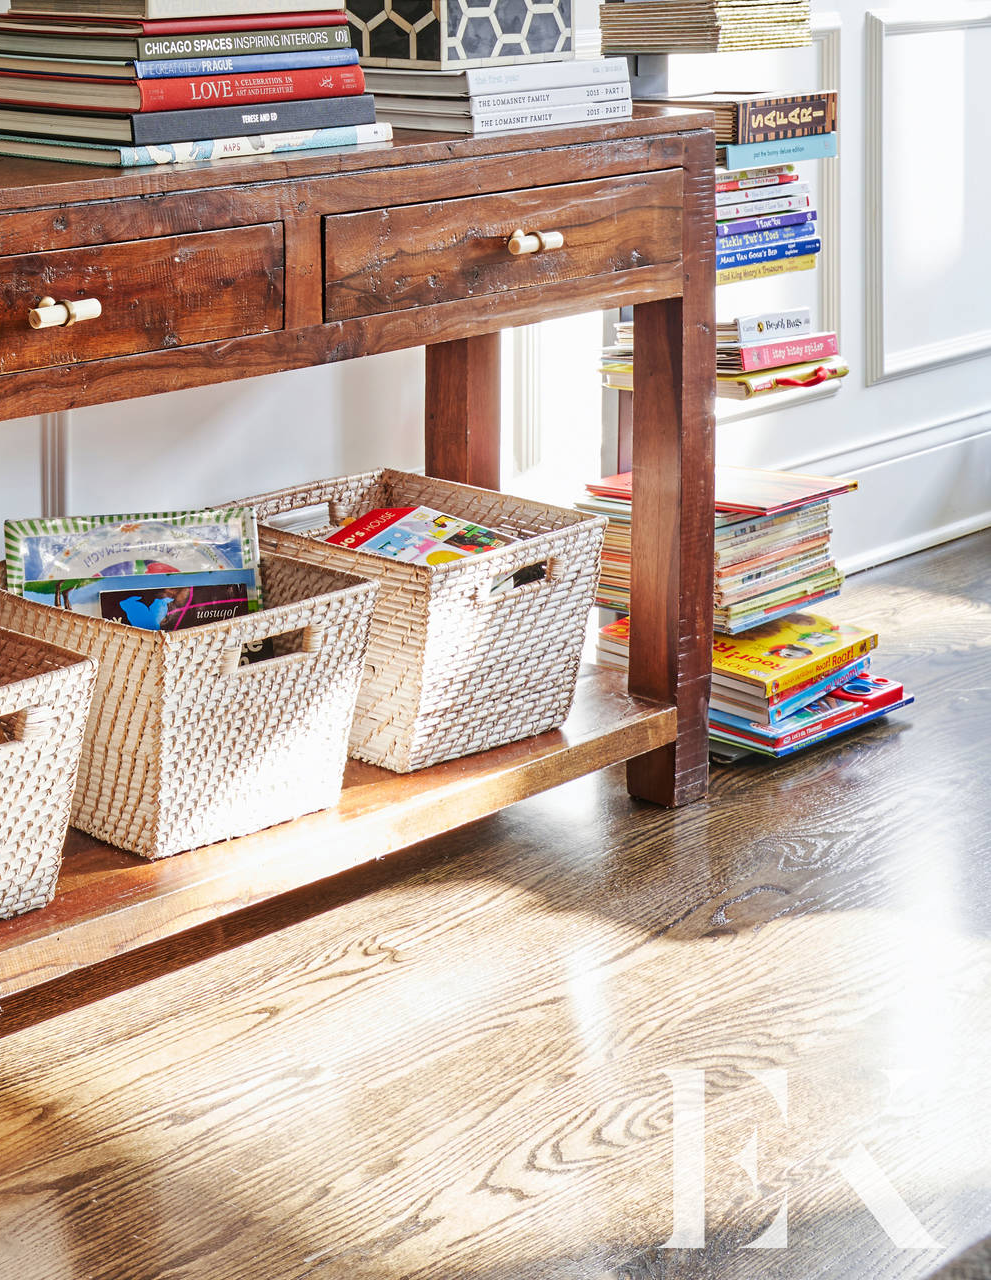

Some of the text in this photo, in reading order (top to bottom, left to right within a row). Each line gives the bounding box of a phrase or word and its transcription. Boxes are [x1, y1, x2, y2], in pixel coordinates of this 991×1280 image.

[144, 31, 328, 56] CHICAGO SPACES INSPIRING INTERIORS
[201, 59, 234, 73] PRAGUE
[190, 80, 234, 101] LOVE
[241, 77, 283, 87] CELEBRATION
[235, 85, 293, 97] ART AND LITERATURE
[478, 99, 491, 107] THE
[493, 96, 526, 107] LOMASNEY
[527, 94, 550, 104] FAMILY
[605, 87, 620, 95] PART
[242, 112, 278, 125] TERESE AND ED
[481, 119, 494, 128] THE
[495, 116, 529, 127] LOMASNEY
[530, 113, 552, 124] FAMILY
[605, 106, 620, 115] PART
[621, 105, 626, 113] II
[751, 105, 825, 129] SAFARI
[223, 142, 241, 153] MAPS
[719, 237, 742, 248] Tickle
[720, 257, 735, 265] MAKE
[749, 250, 767, 259] GOGH'S
[768, 248, 777, 256] BED
[787, 316, 802, 328] Bugs
[772, 342, 824, 358] itsy bitsy spider
[365, 511, 396, 532] HOUSE
[83, 541, 131, 567] ZEMACH
[197, 605, 238, 619] johnson
[816, 646, 854, 672] Roar! Roar!
[834, 665, 858, 686] Vroom!
